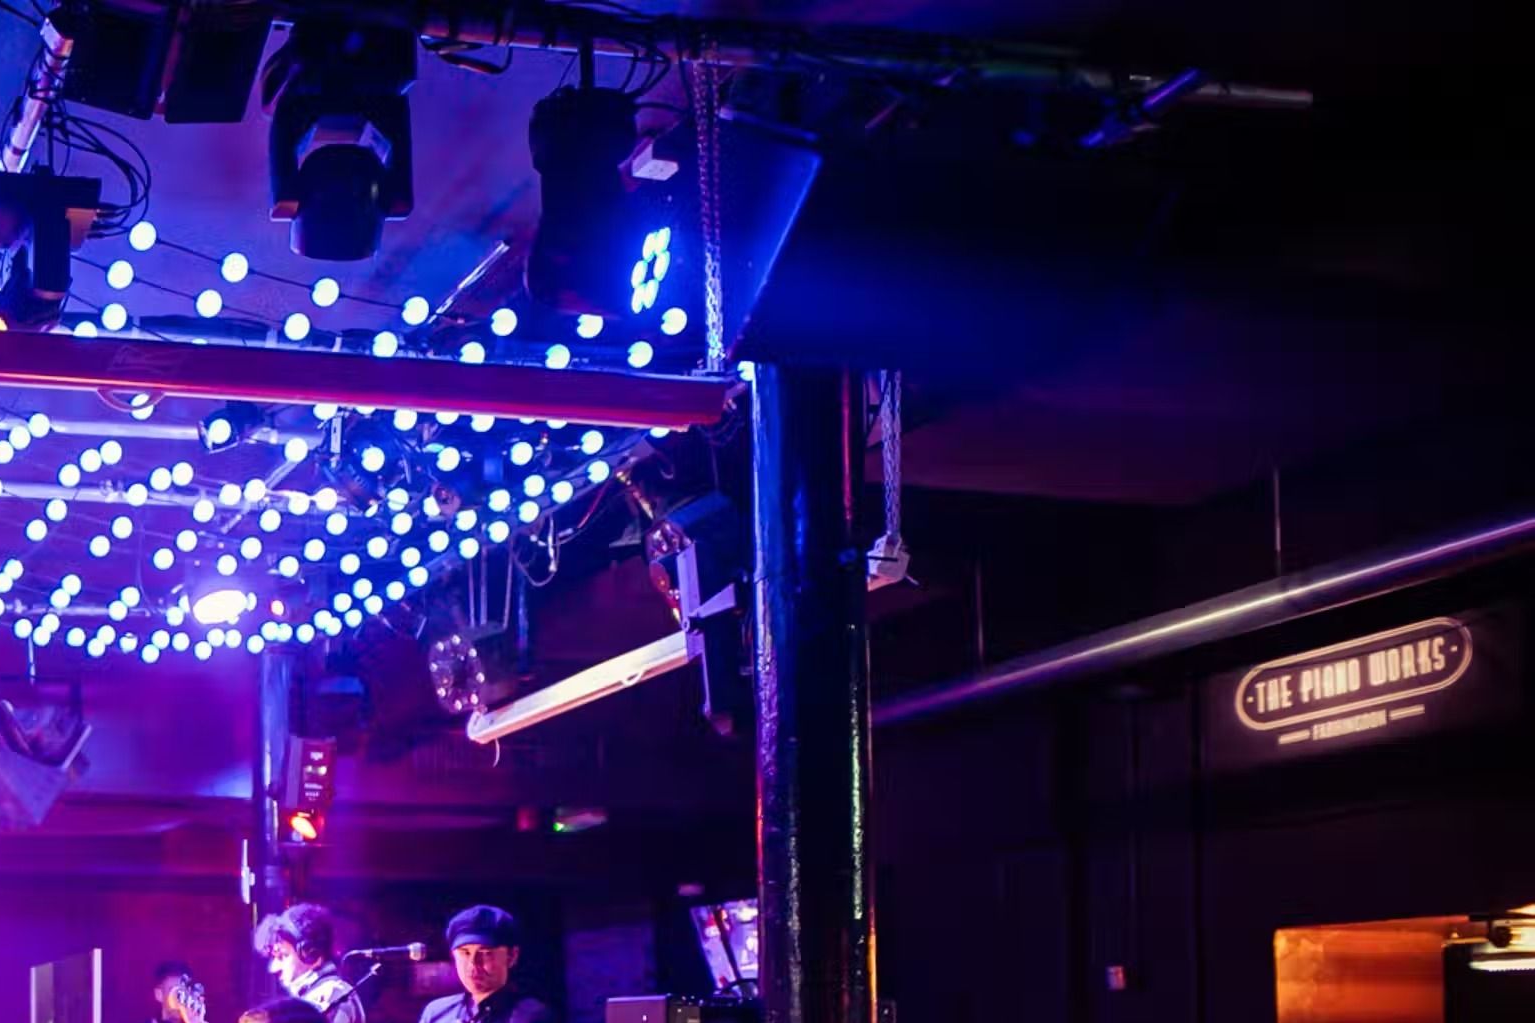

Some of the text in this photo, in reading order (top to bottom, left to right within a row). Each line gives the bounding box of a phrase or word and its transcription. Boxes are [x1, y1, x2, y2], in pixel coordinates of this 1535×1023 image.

[1255, 636, 1446, 714] THE PIANO WORKS
